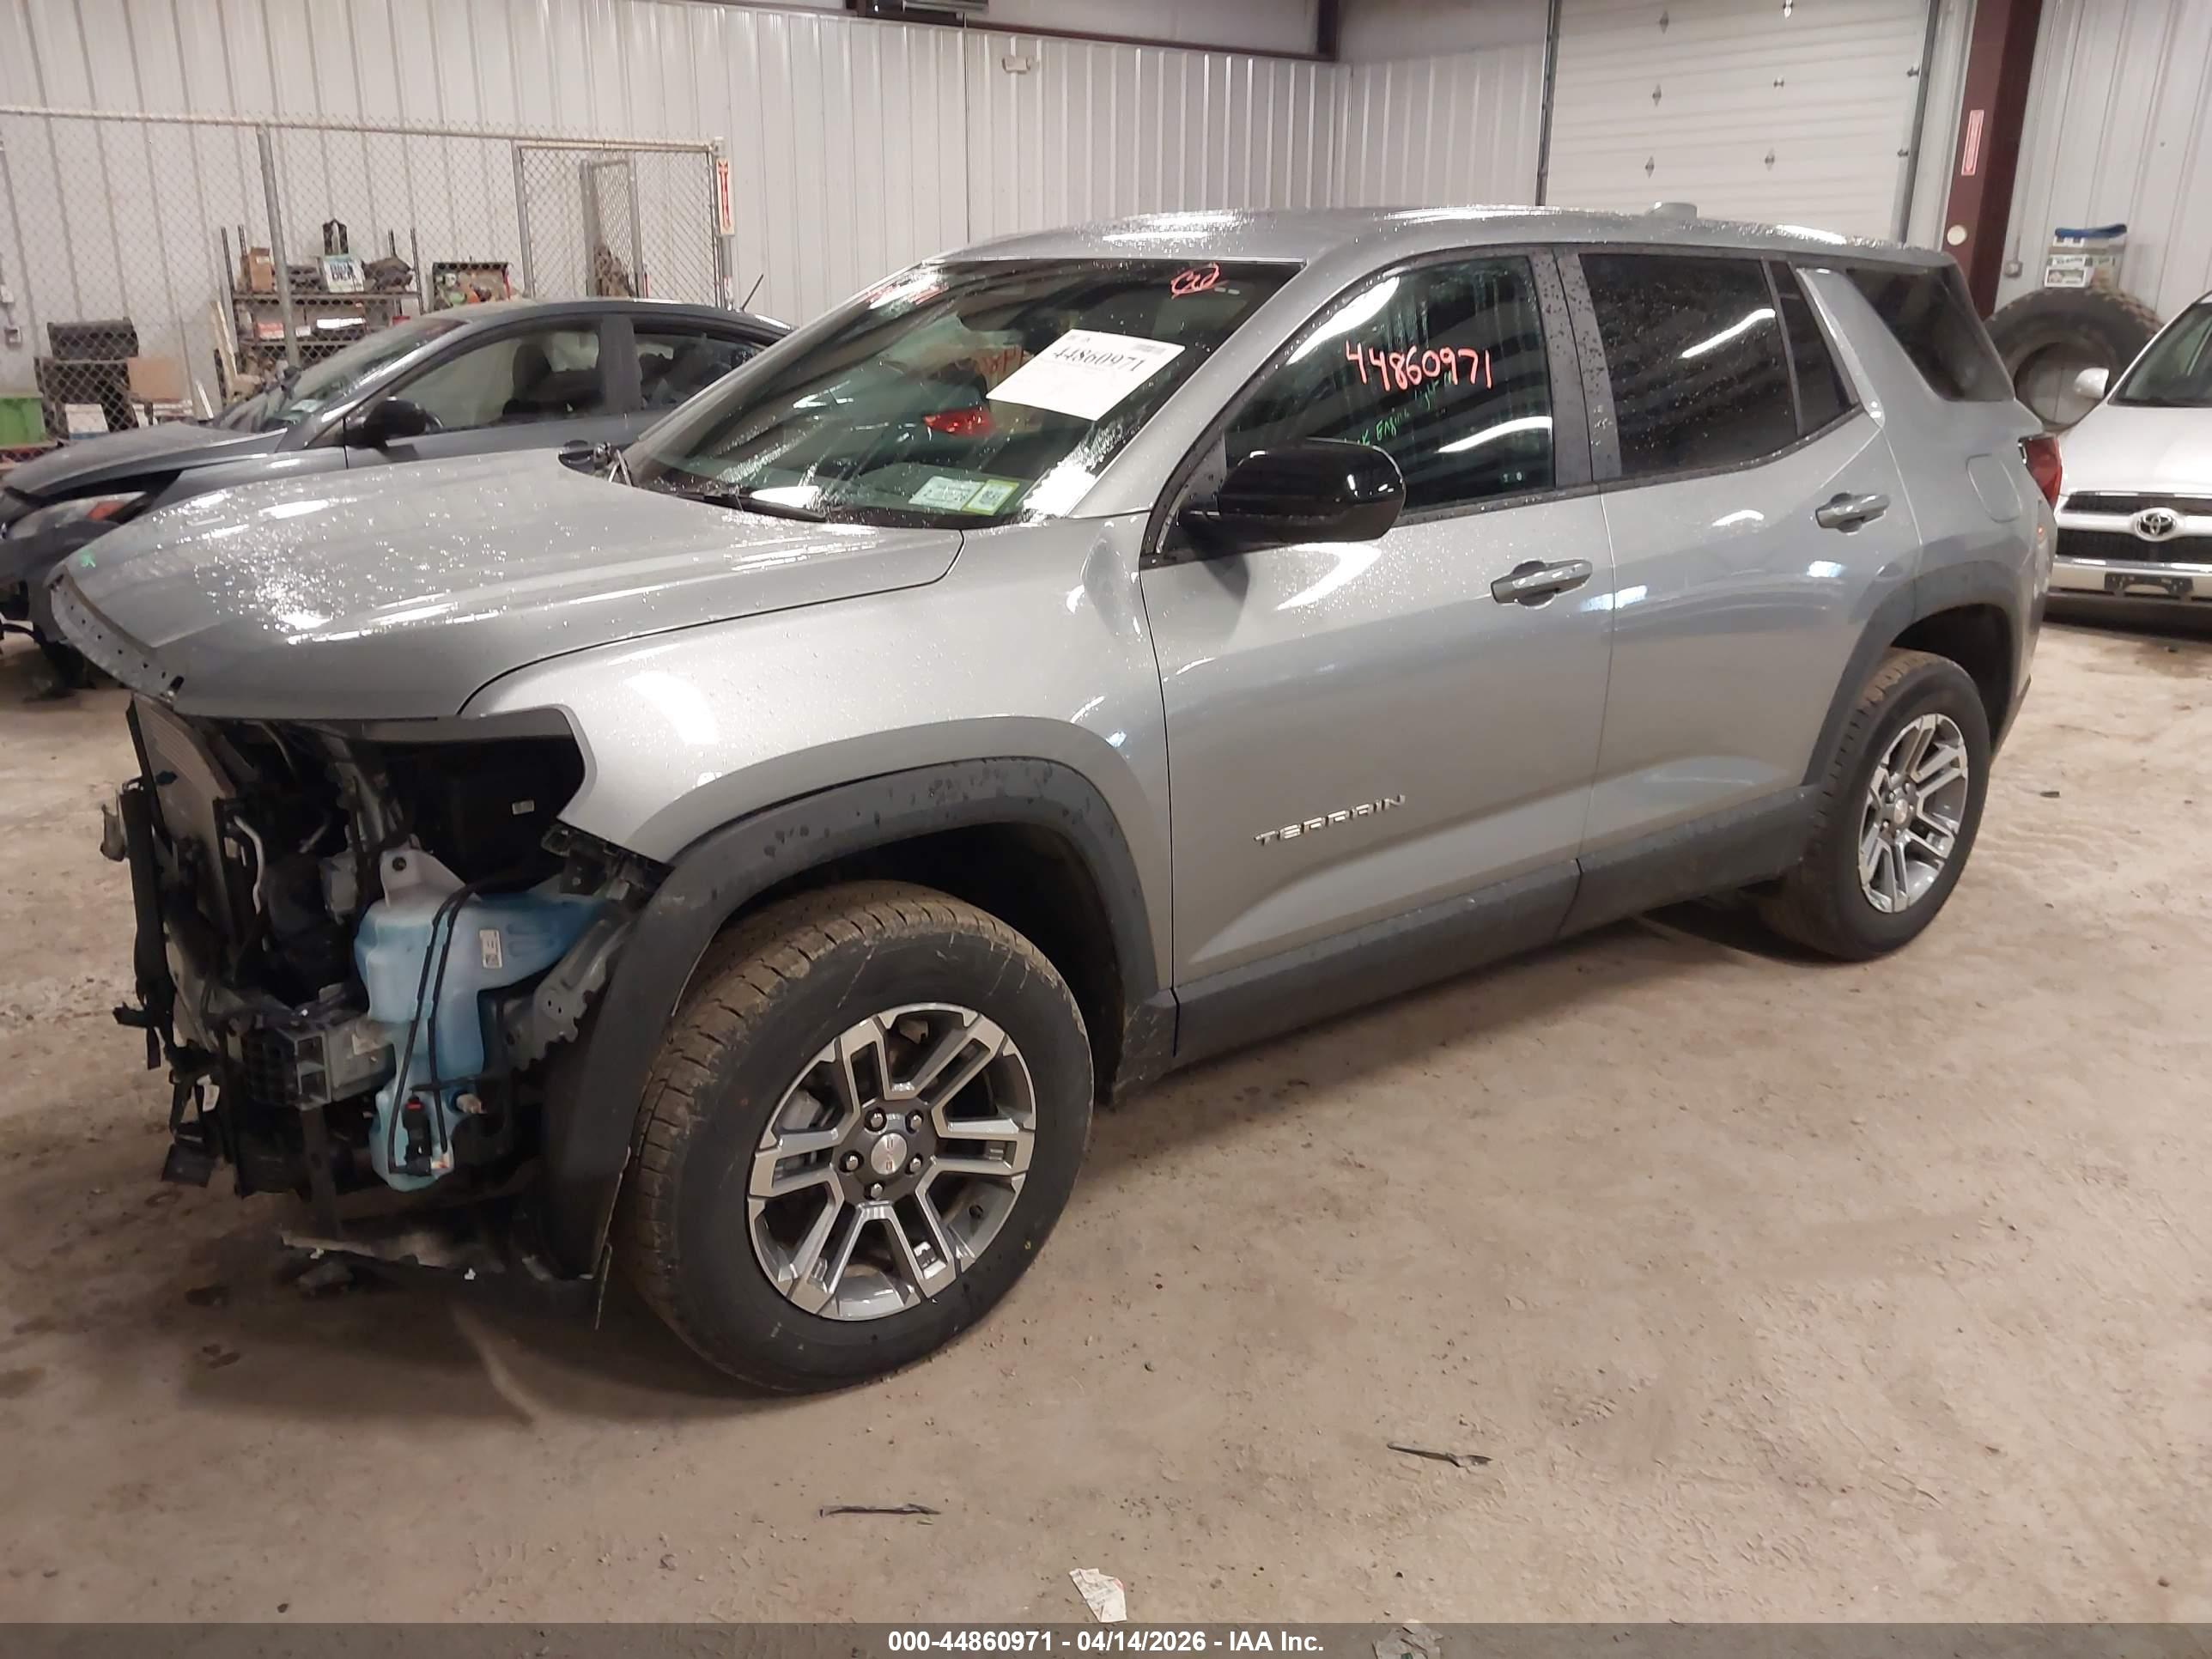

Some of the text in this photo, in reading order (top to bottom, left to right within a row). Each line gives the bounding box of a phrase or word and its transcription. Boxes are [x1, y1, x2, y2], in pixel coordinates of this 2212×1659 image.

[1053, 347, 1147, 372] 44860971
[1346, 340, 1492, 391] 44860971
[1254, 794, 1406, 846] TERRAIN
